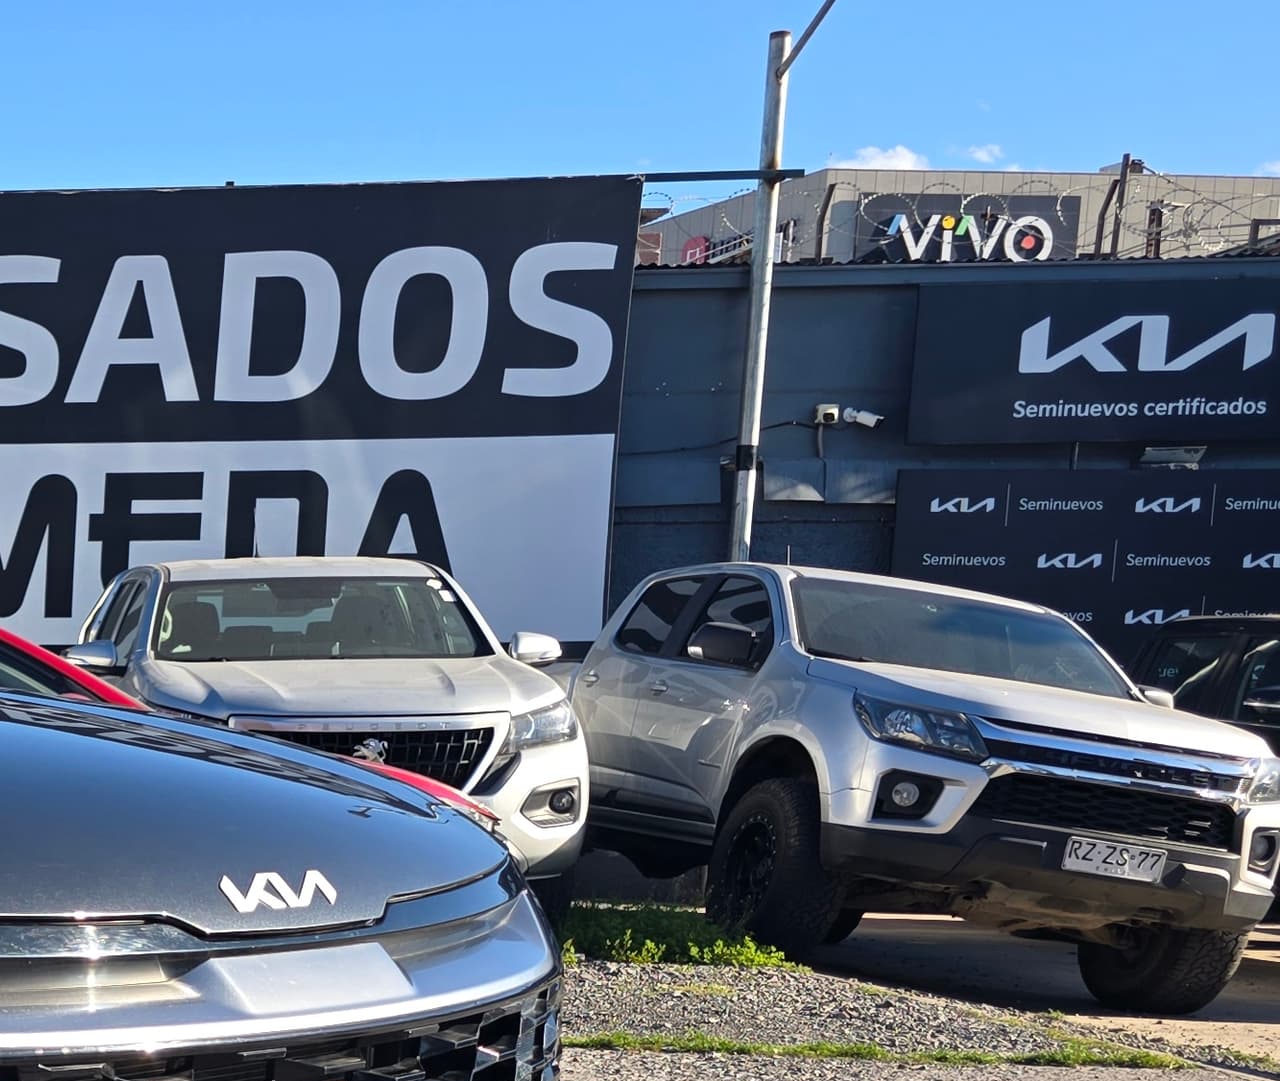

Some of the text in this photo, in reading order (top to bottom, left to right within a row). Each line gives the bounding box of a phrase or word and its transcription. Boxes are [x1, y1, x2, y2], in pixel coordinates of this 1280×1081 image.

[1018, 313, 1276, 373] KIA
[1013, 397, 1268, 417] Seminuevos certificados
[1018, 498, 1104, 511] Seminuevos
[1224, 498, 1280, 511] Seminu
[922, 553, 1006, 566] Seminuevos
[1126, 553, 1211, 566] Seminuevos
[1242, 553, 1280, 568] KI
[218, 869, 337, 913] KIA
